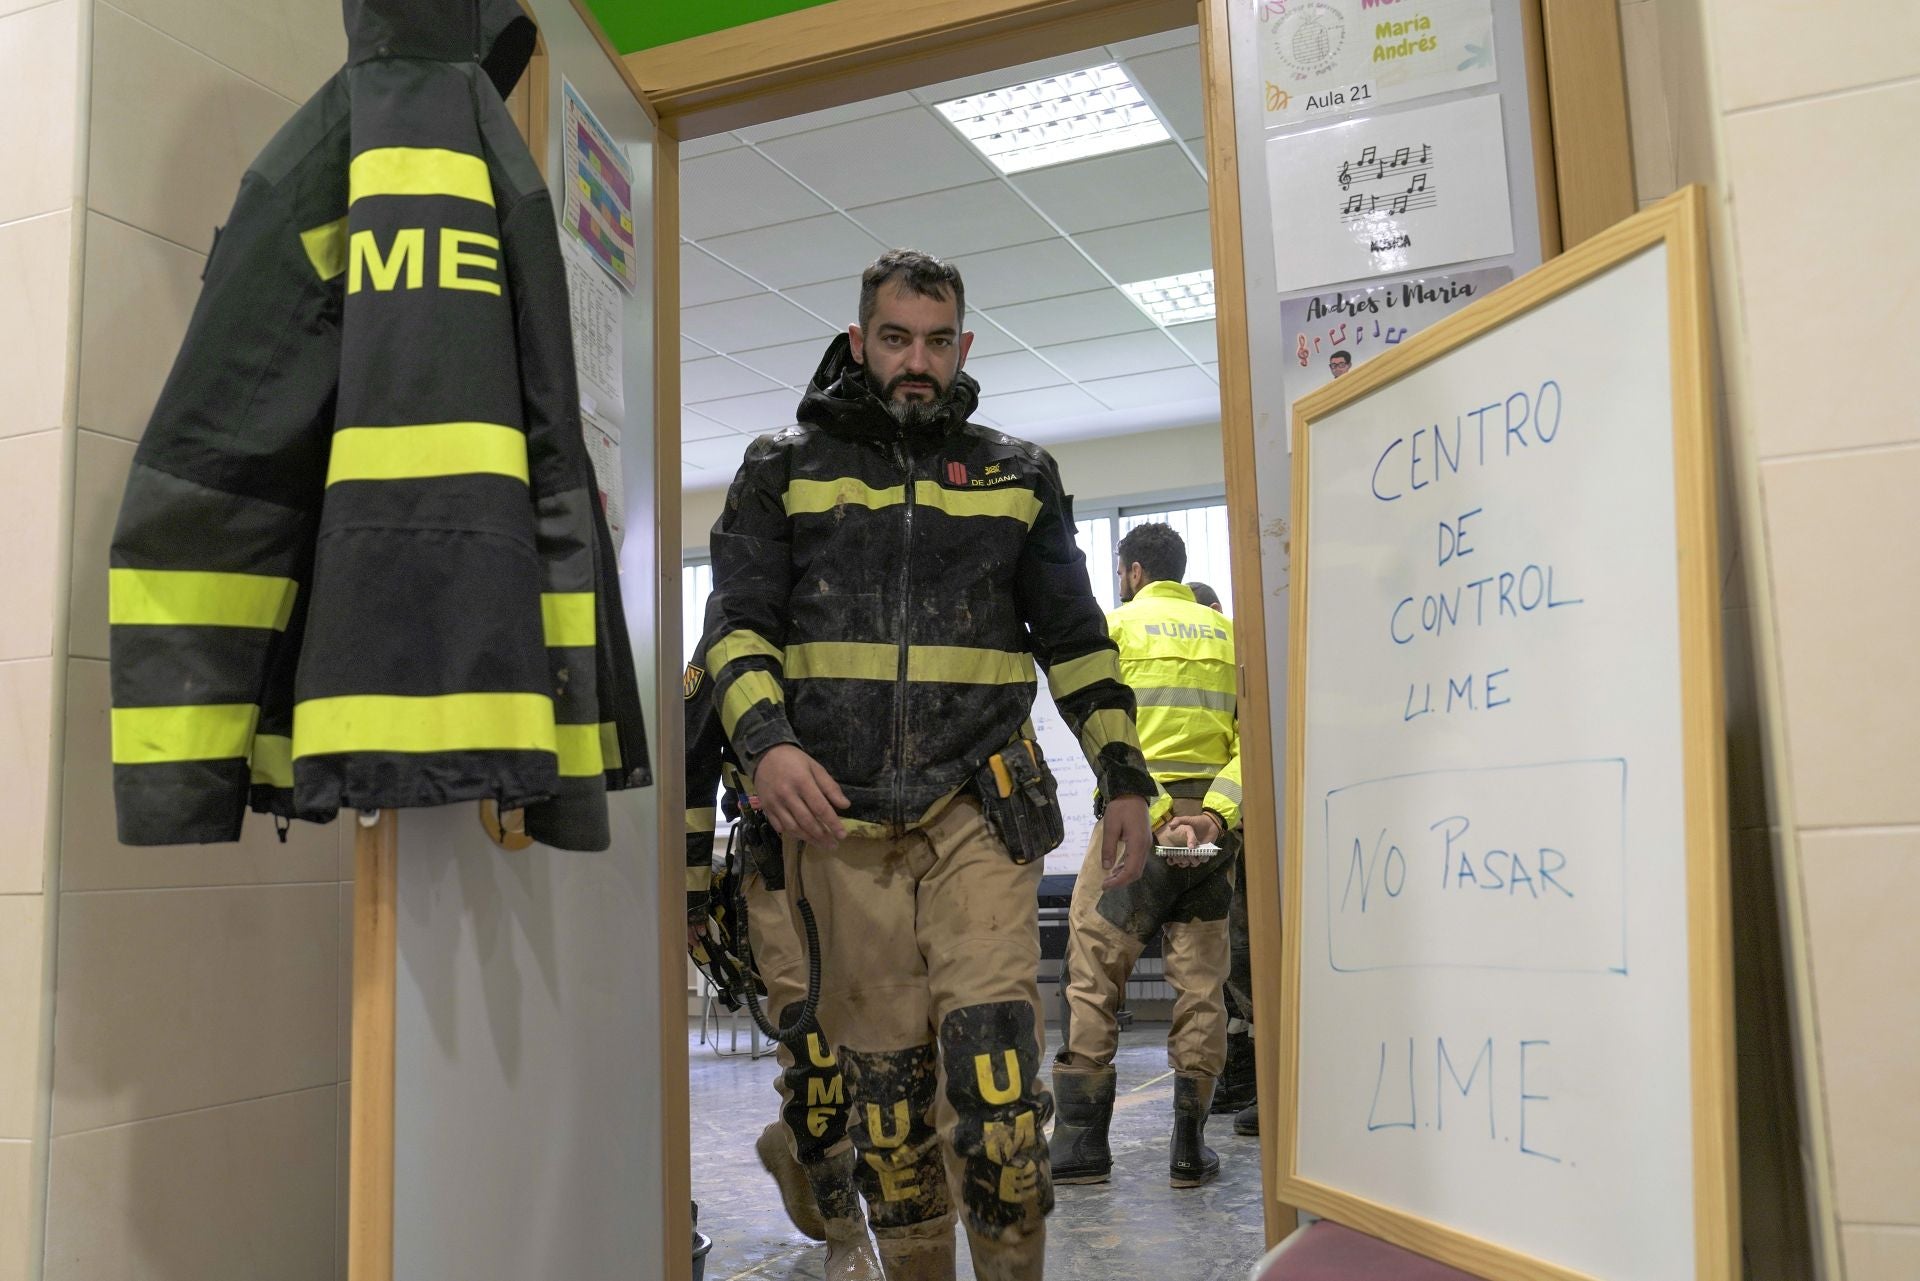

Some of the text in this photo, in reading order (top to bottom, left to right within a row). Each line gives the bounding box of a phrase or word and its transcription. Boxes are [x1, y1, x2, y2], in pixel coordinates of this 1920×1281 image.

[1375, 13, 1431, 40] María
[1373, 33, 1437, 63] Andrés
[1306, 84, 1372, 111] Aula 21
[1307, 292, 1380, 322] Andres
[1402, 281, 1477, 308] Maria
[1372, 380, 1562, 501] CENTRO
[986, 474, 1018, 486] JUANA
[1438, 508, 1483, 567] DE
[1391, 564, 1584, 644] CONTROL
[1161, 622, 1214, 640] UME
[1341, 815, 1574, 913] NO PASAR
